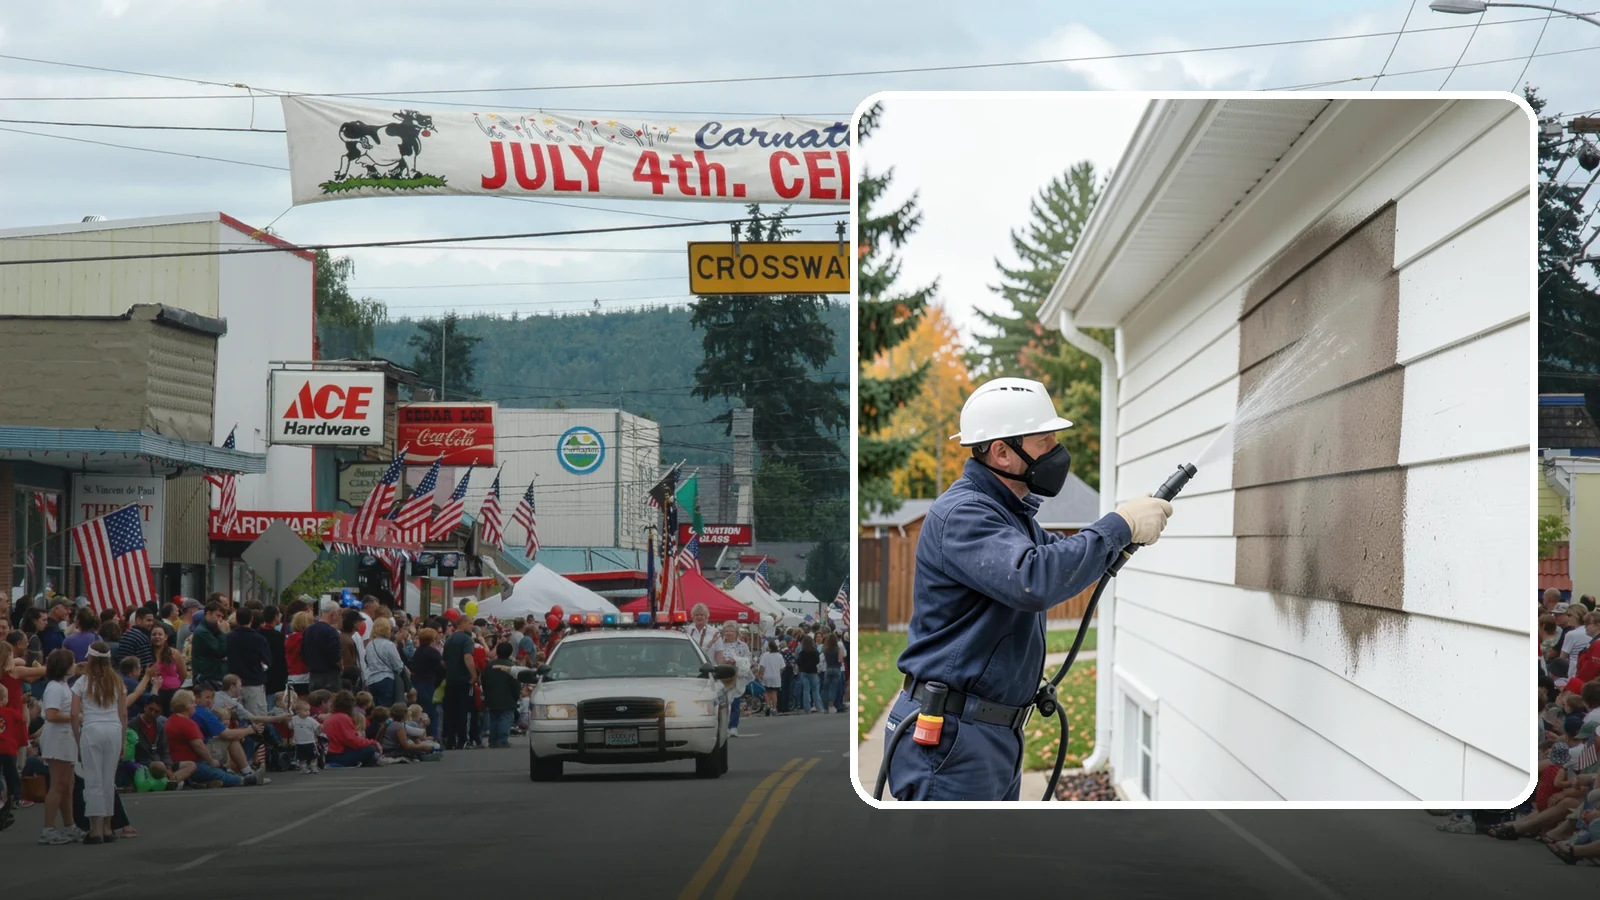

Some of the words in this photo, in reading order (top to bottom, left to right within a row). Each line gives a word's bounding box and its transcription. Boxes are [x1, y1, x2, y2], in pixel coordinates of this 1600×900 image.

[481, 140, 605, 193] JULY
[632, 149, 746, 198] 4th.
[696, 254, 850, 280] CROSSWA
[282, 379, 374, 420] ACE
[405, 409, 453, 422] CEDAR
[461, 409, 485, 422] LOG
[283, 421, 371, 437] Hardware
[416, 428, 477, 447] Coca-Cola
[83, 485, 93, 494] St.
[95, 486, 124, 495] Vincent
[126, 486, 135, 495] de
[137, 486, 155, 495] Paul
[212, 515, 331, 536] HARDARE
[688, 526, 741, 535] CRNATION
[699, 535, 730, 544] GLASS
